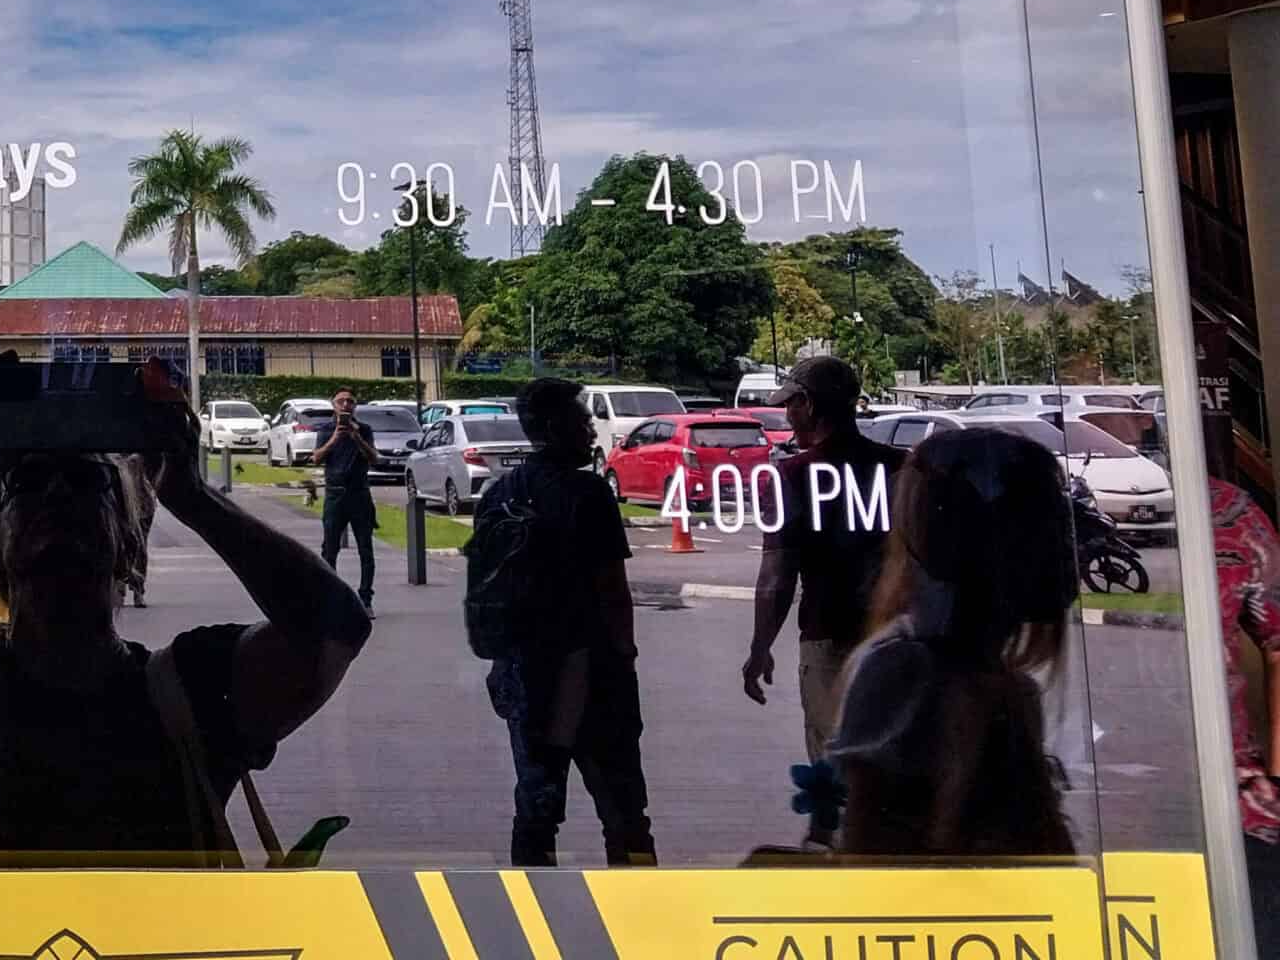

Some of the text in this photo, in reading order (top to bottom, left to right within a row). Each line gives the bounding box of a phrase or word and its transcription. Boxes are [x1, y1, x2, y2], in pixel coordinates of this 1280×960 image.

[336, 159, 867, 228] 9:30 AM - 4.30 PM
[1197, 376, 1230, 386] TRASI
[1198, 386, 1230, 410] AF
[808, 462, 891, 533] PM
